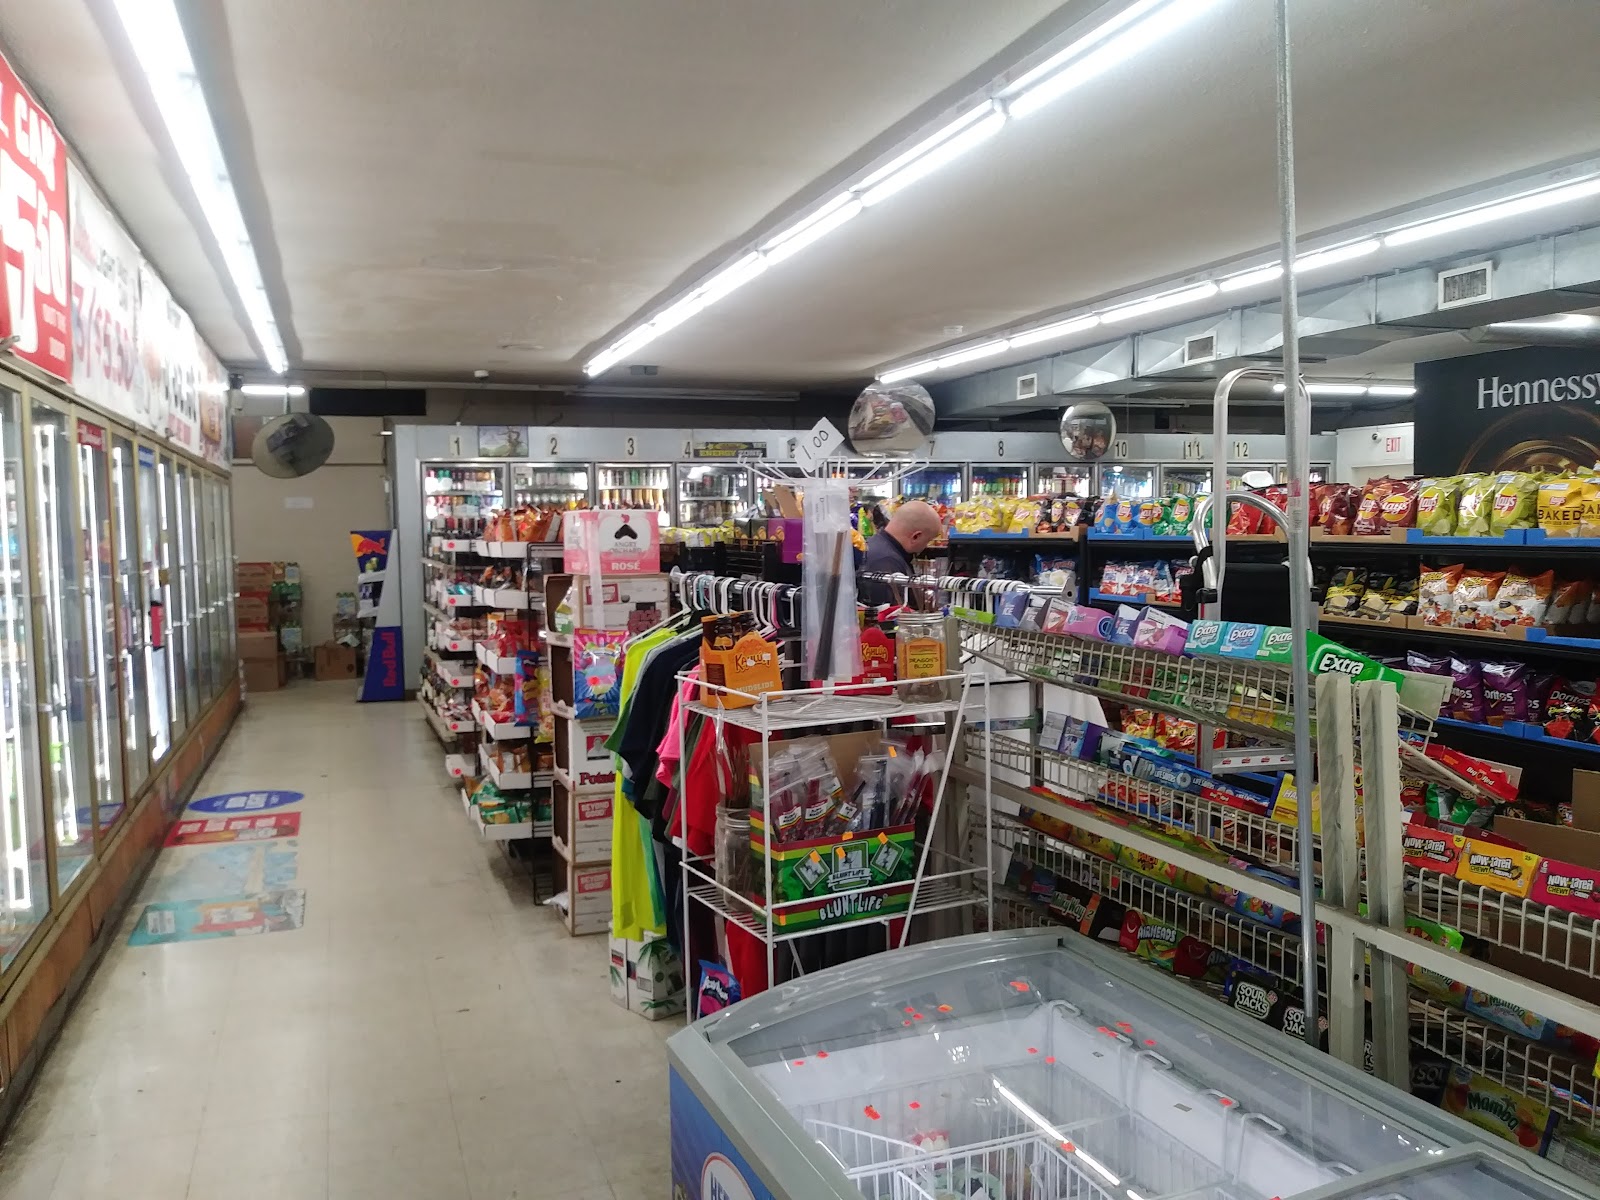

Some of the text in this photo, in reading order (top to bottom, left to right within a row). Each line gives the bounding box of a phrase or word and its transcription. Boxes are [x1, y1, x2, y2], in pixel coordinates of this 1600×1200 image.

[454, 437, 461, 456] 1
[550, 437, 558, 455] 2
[627, 438, 635, 456] 3
[684, 441, 691, 458] 4
[929, 440, 936, 456] 7
[998, 441, 1005, 456] 8
[1115, 441, 1127, 457] 10
[1236, 442, 1249, 457] 12
[1386, 437, 1401, 452] EXIT
[1538, 509, 1581, 521] BAKED
[611, 560, 641, 570] ROSÉ
[1002, 607, 1014, 616] ICE
[1116, 626, 1129, 634] ICE
[1195, 625, 1219, 638] Extra
[1230, 627, 1255, 641] Extra
[1267, 632, 1292, 645] Extra
[1319, 653, 1365, 676] Extra
[736, 681, 775, 692] MUDSLIDE
[1550, 690, 1592, 706] Doritos
[1466, 766, 1495, 786] Big Red
[1404, 837, 1422, 848] NOW
[1470, 854, 1489, 866] NOW
[1547, 875, 1568, 886] NOW
[1548, 886, 1569, 895] CHEWY
[820, 893, 883, 921] BLUNTLIFE
[1137, 925, 1177, 942] AIRHEADS
[1239, 983, 1265, 1001] SOUR
[1238, 994, 1269, 1014] JACKS
[1288, 1010, 1304, 1024] SOU
[1286, 1021, 1304, 1035] JAC
[1467, 1092, 1520, 1132] Mambo
